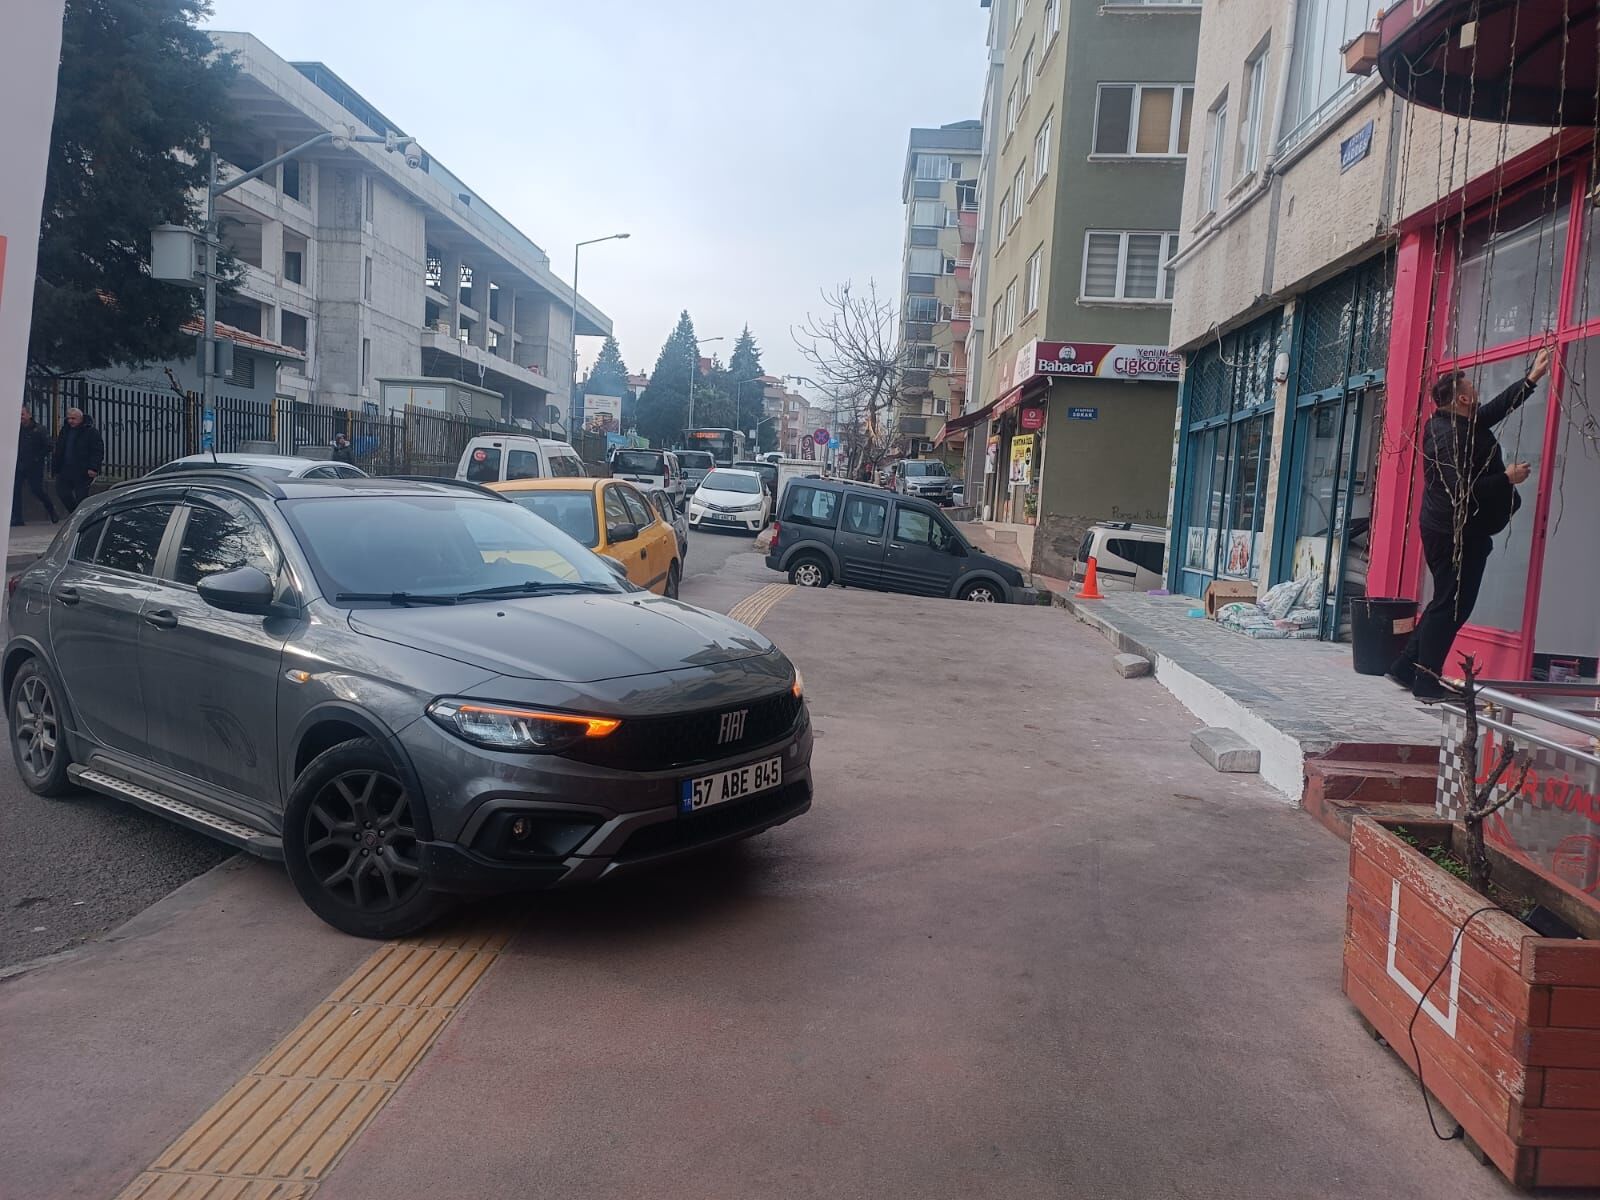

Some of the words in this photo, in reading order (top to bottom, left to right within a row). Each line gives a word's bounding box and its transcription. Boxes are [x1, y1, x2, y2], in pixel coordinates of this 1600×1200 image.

[1114, 356, 1180, 376] Çiğköfte
[718, 709, 749, 745] FIAT
[694, 776, 714, 807] 57
[721, 768, 749, 799] ABE
[754, 760, 779, 789] 845
